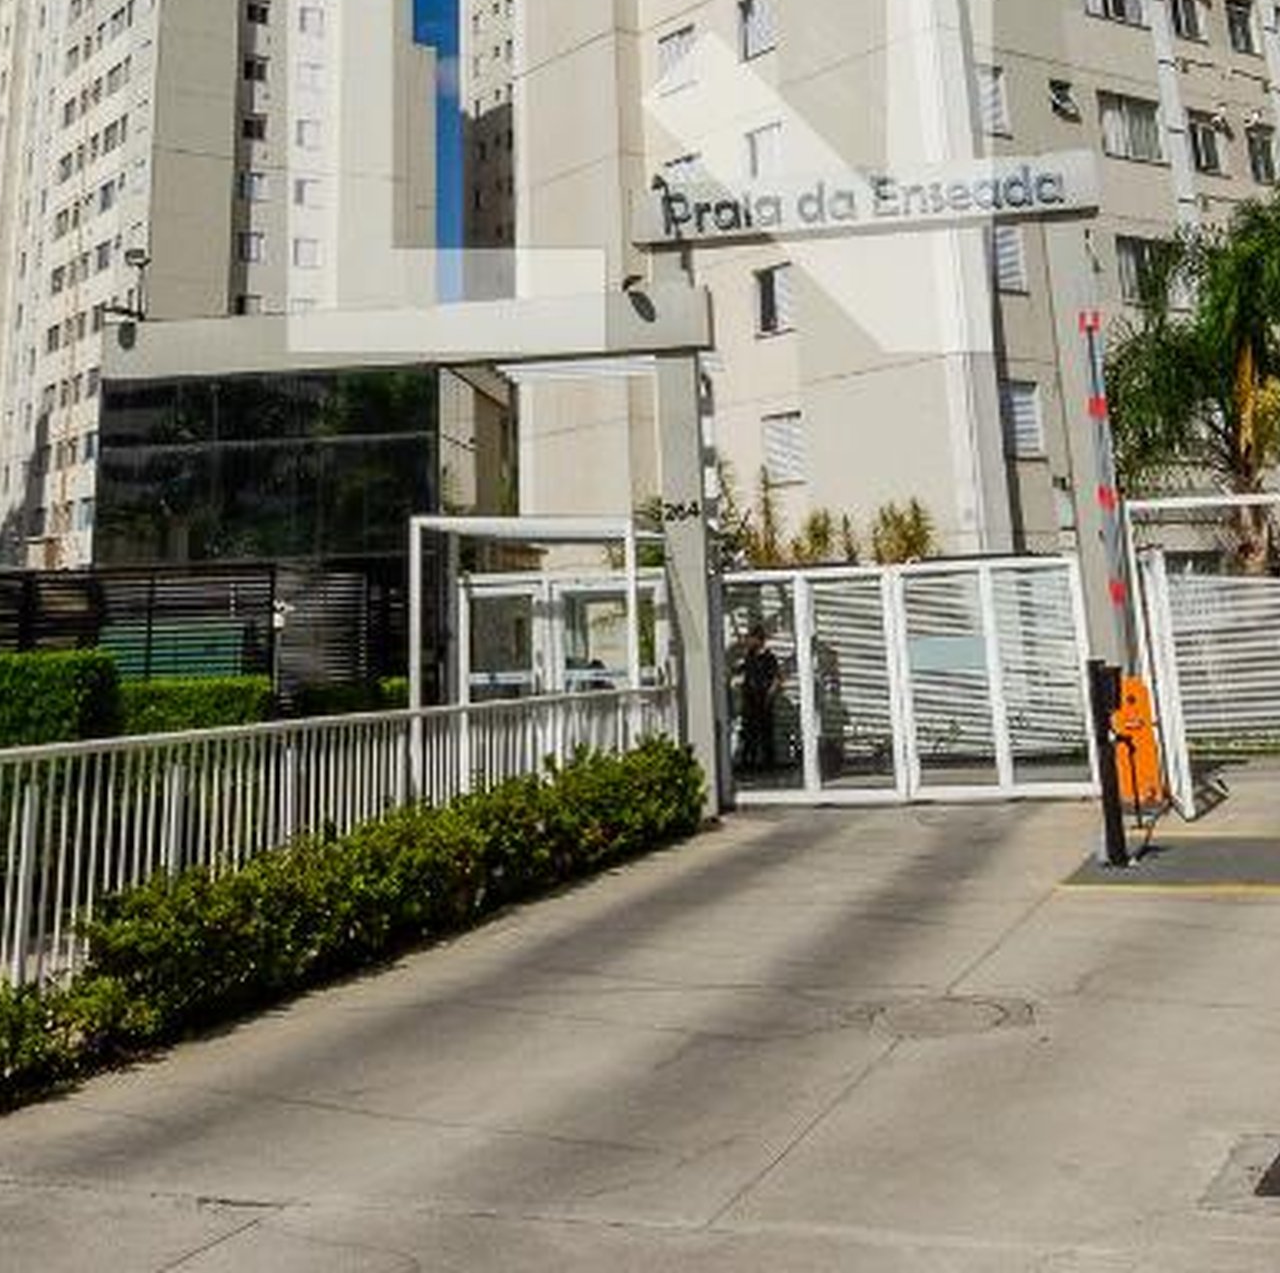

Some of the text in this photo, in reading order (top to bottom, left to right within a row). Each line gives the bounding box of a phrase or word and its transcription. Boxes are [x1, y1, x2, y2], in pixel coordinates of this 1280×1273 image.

[662, 165, 1065, 235] Praia da Enseada
